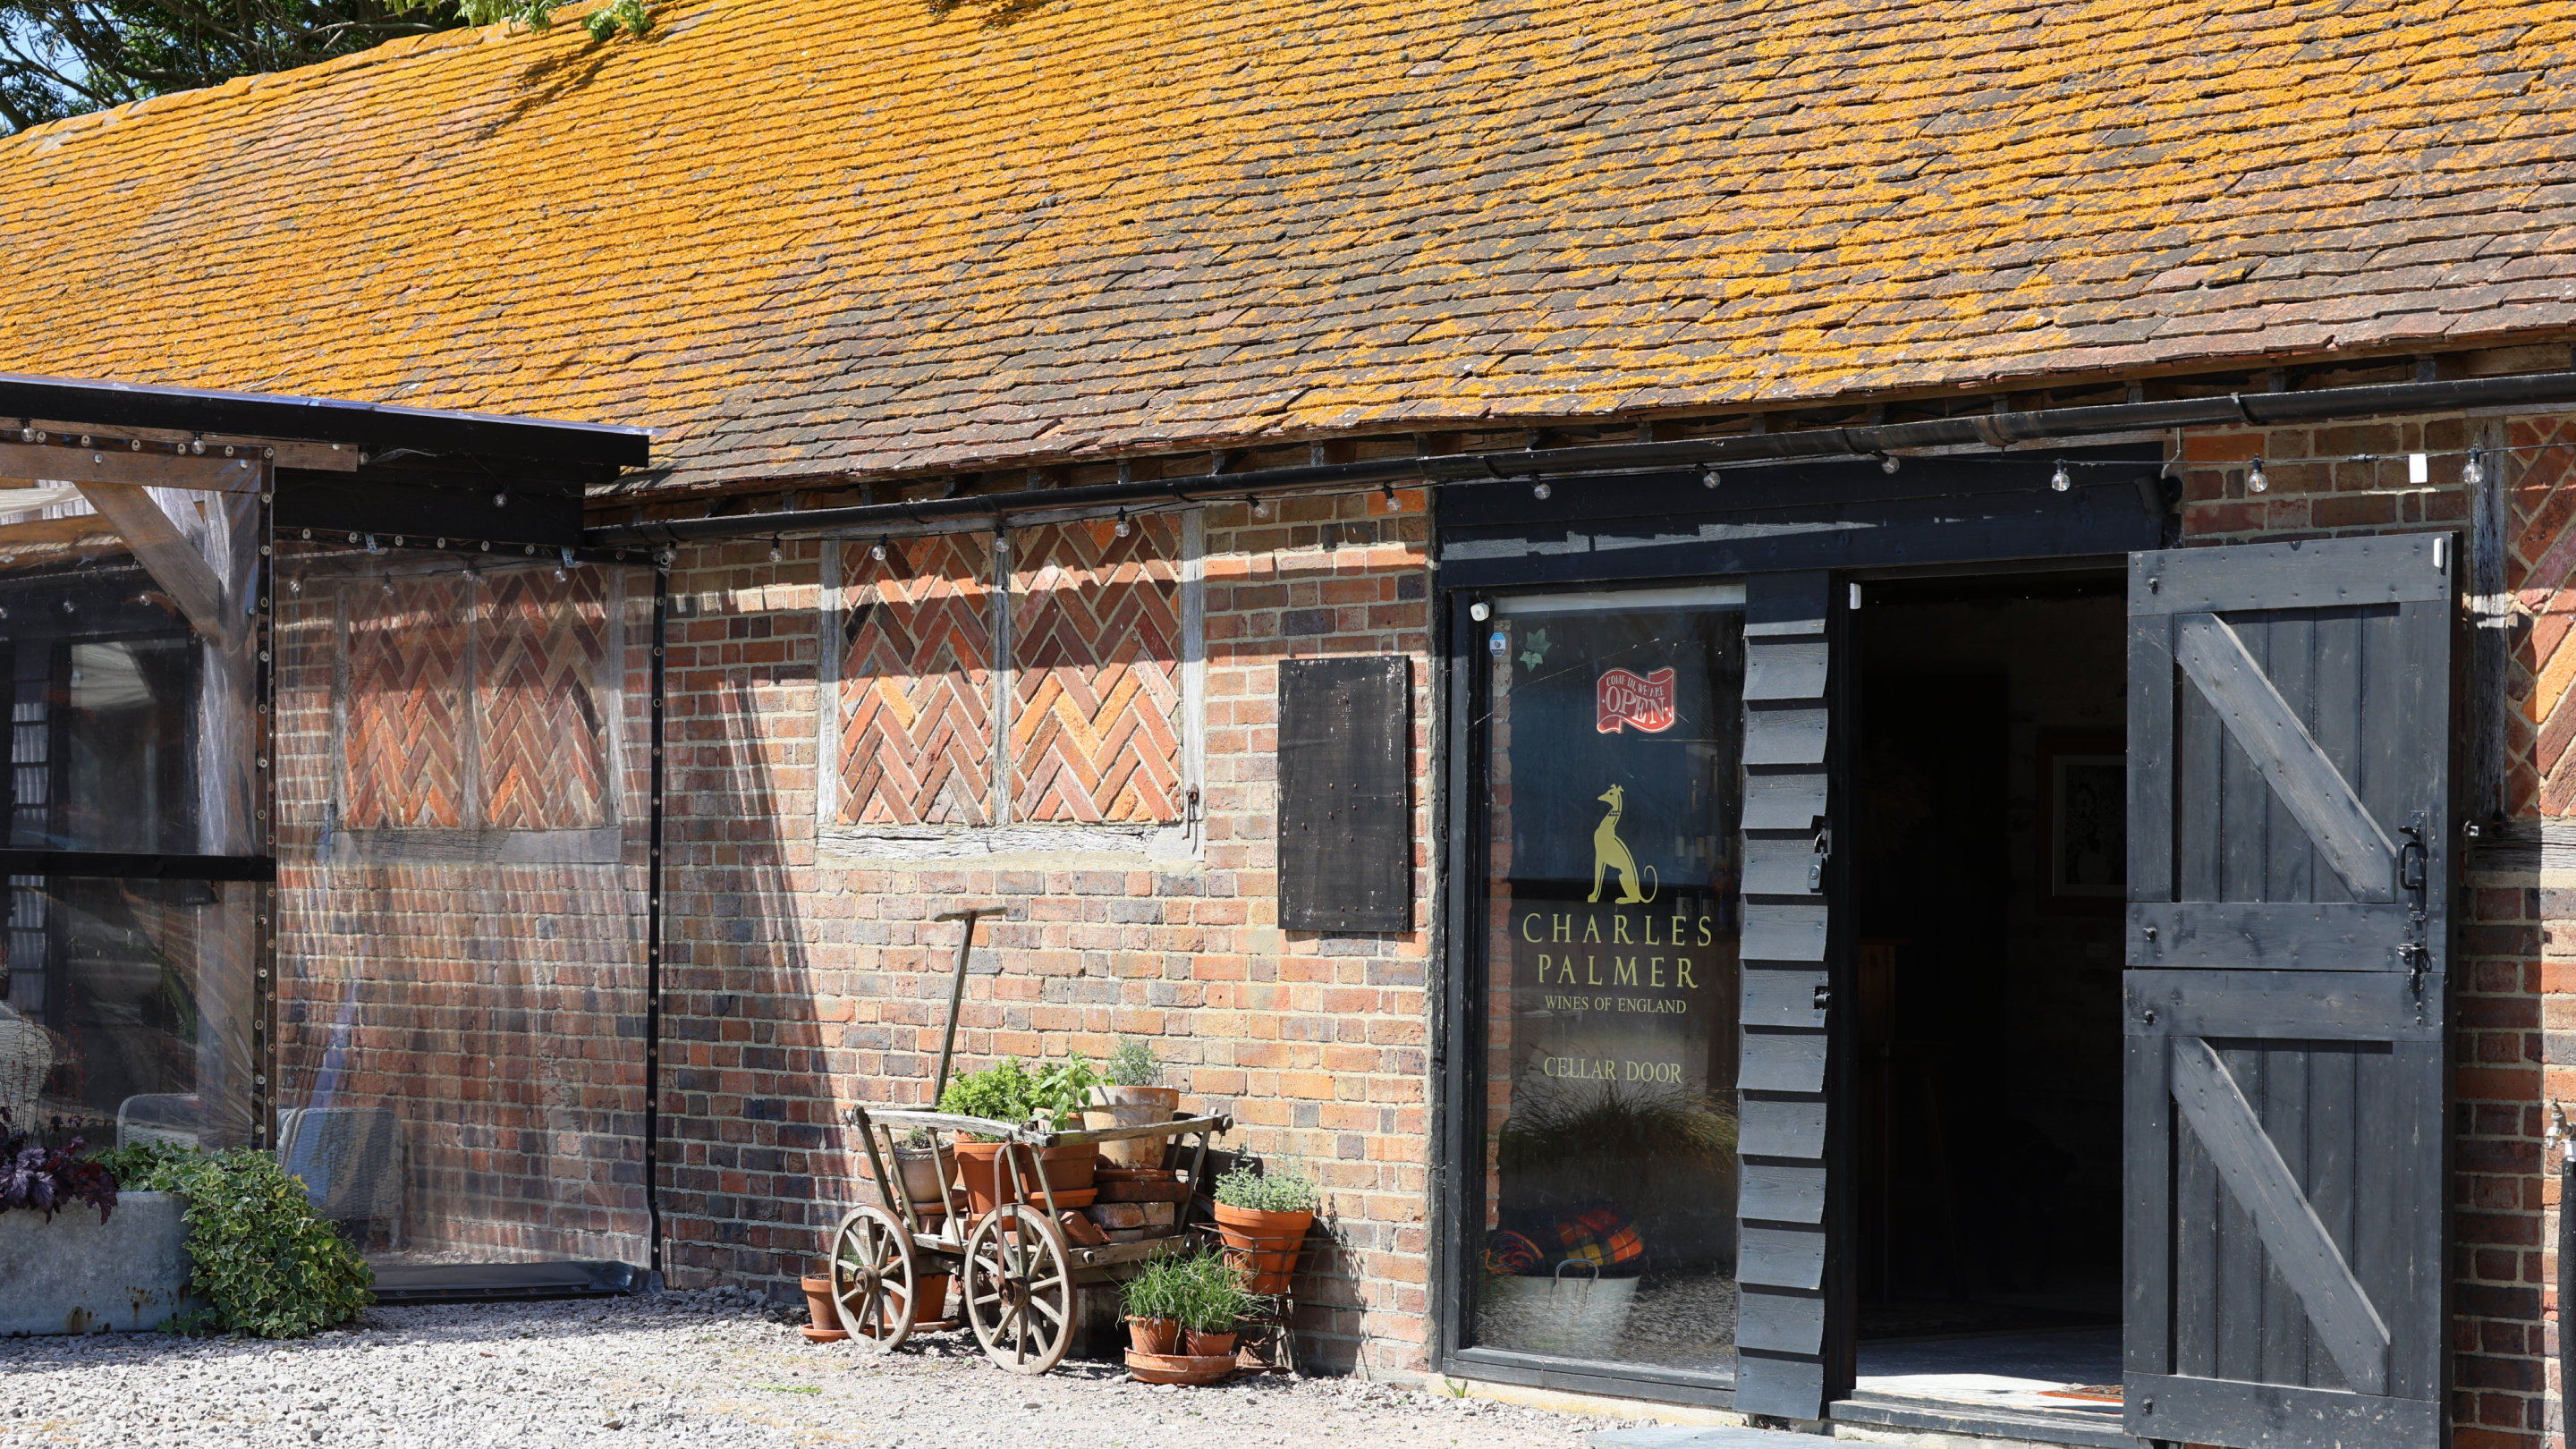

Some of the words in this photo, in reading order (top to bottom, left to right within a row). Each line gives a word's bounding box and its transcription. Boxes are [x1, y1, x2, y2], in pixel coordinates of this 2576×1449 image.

[1606, 674, 1625, 687] COME
[1638, 683, 1649, 696] WE
[1649, 686, 1665, 697] ARE
[1606, 686, 1665, 724] OPEN
[1522, 912, 1712, 946] CHARLES
[1538, 954, 1699, 988] PALMER
[1545, 996, 1589, 1010] WINES
[1595, 997, 1611, 1011] OF
[1617, 998, 1687, 1013] ENGLAND
[1544, 1056, 1617, 1080] CELLAR
[1625, 1061, 1683, 1083] DOOR
